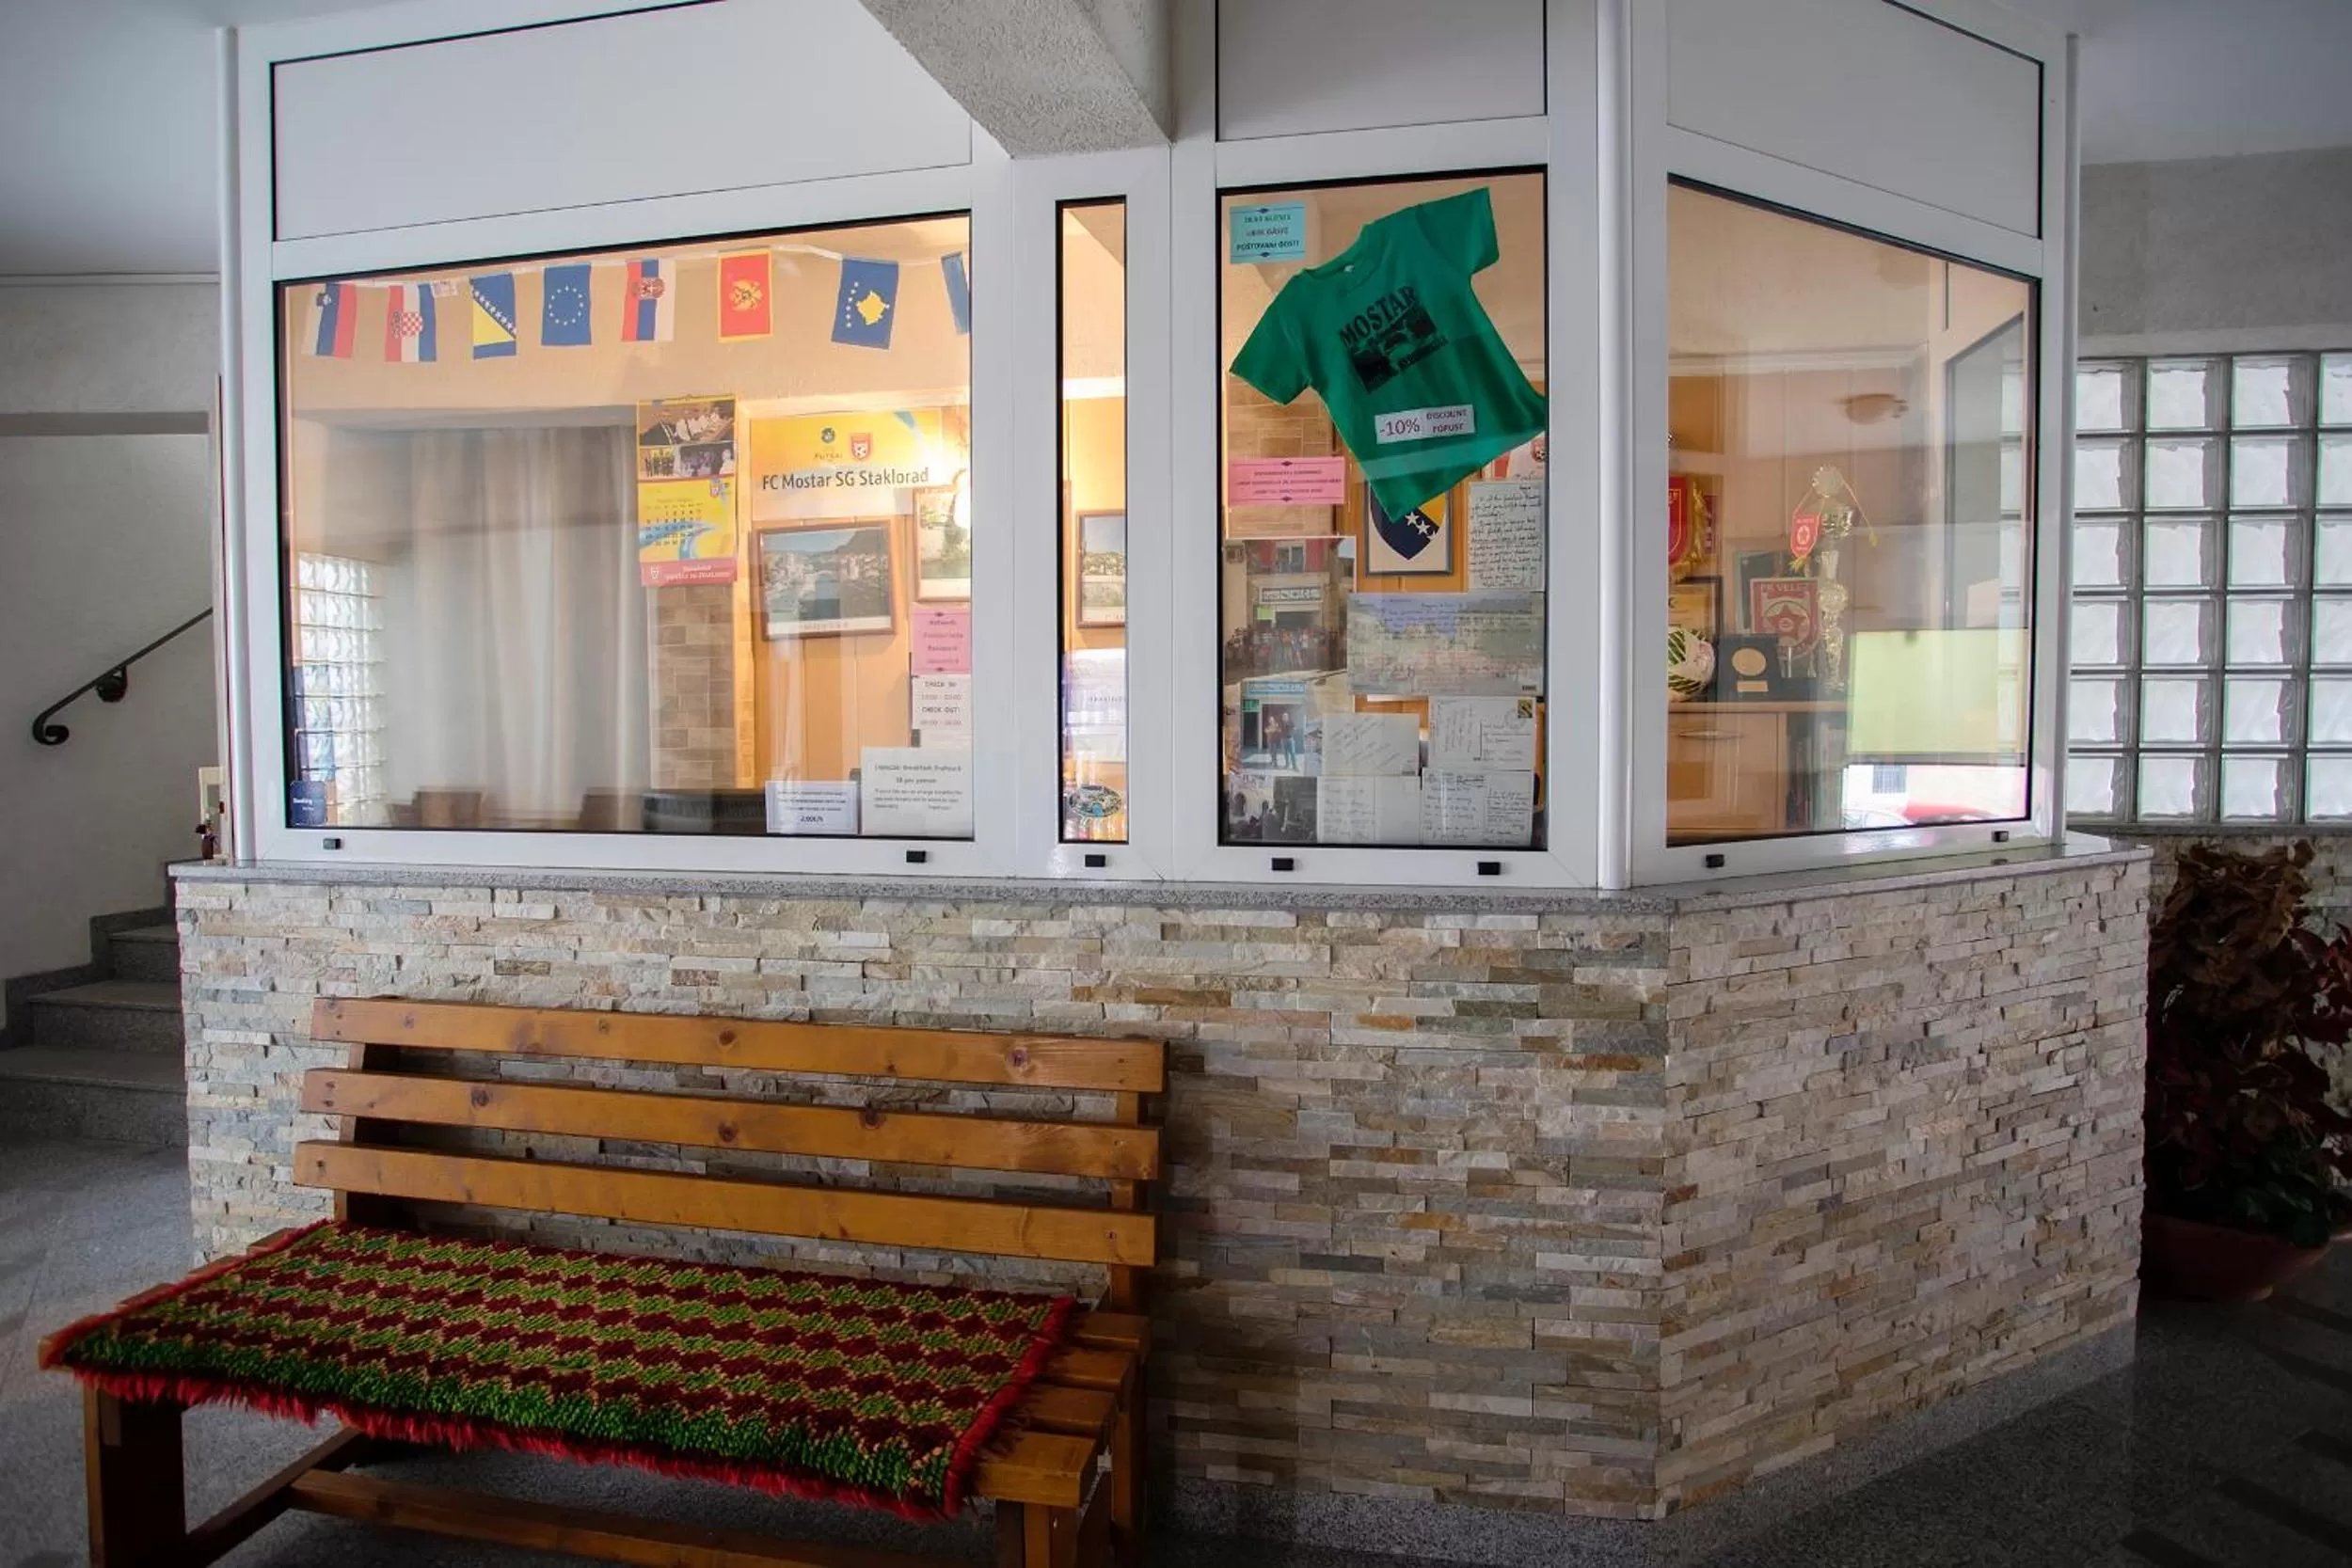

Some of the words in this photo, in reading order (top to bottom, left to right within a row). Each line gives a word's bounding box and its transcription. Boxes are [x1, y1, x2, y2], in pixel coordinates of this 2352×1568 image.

[1338, 285, 1418, 349] MOSTAR
[1380, 418, 1421, 436] -10%
[762, 474, 778, 490] FC
[782, 473, 832, 489] Mostar
[835, 470, 855, 486] SG
[859, 467, 929, 485] Staklorad
